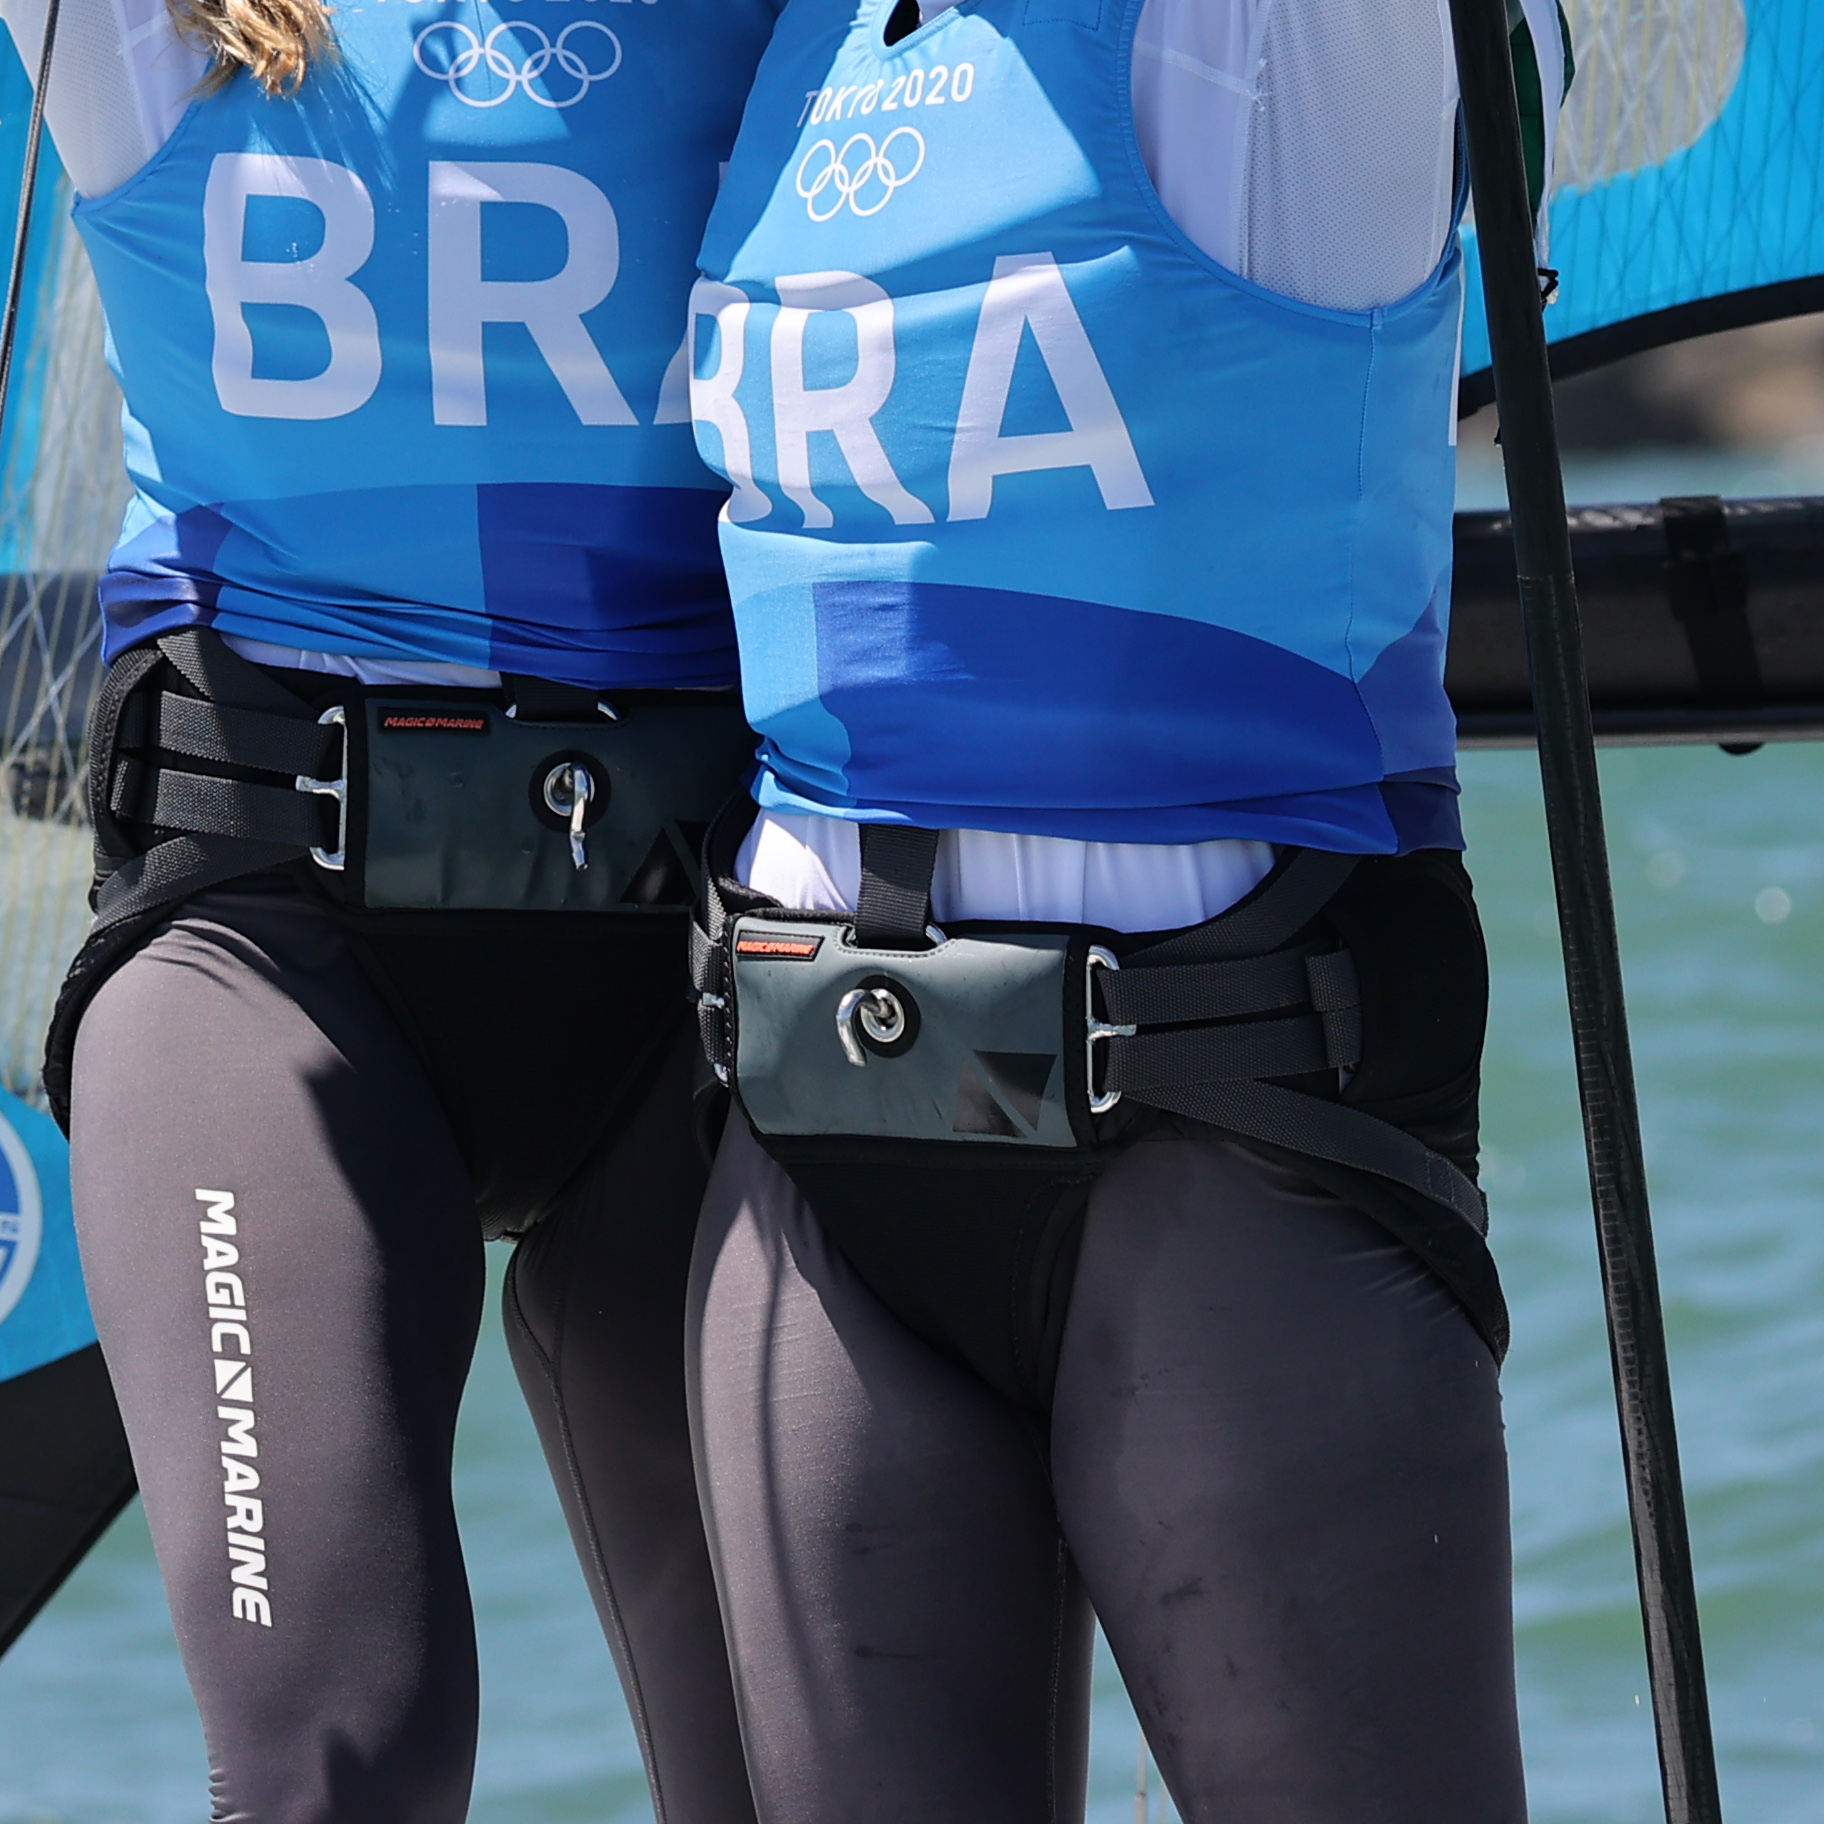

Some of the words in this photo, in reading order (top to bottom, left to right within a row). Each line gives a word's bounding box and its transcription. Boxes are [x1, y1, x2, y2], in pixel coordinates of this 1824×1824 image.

[796, 79, 885, 128] TOKYO
[881, 62, 975, 112] 2020
[203, 152, 729, 426] BR
[688, 251, 1155, 529] BRA
[383, 716, 426, 728] MAGIC
[194, 1188, 252, 1355] MAGIC
[217, 1405, 273, 1627] MARINE
